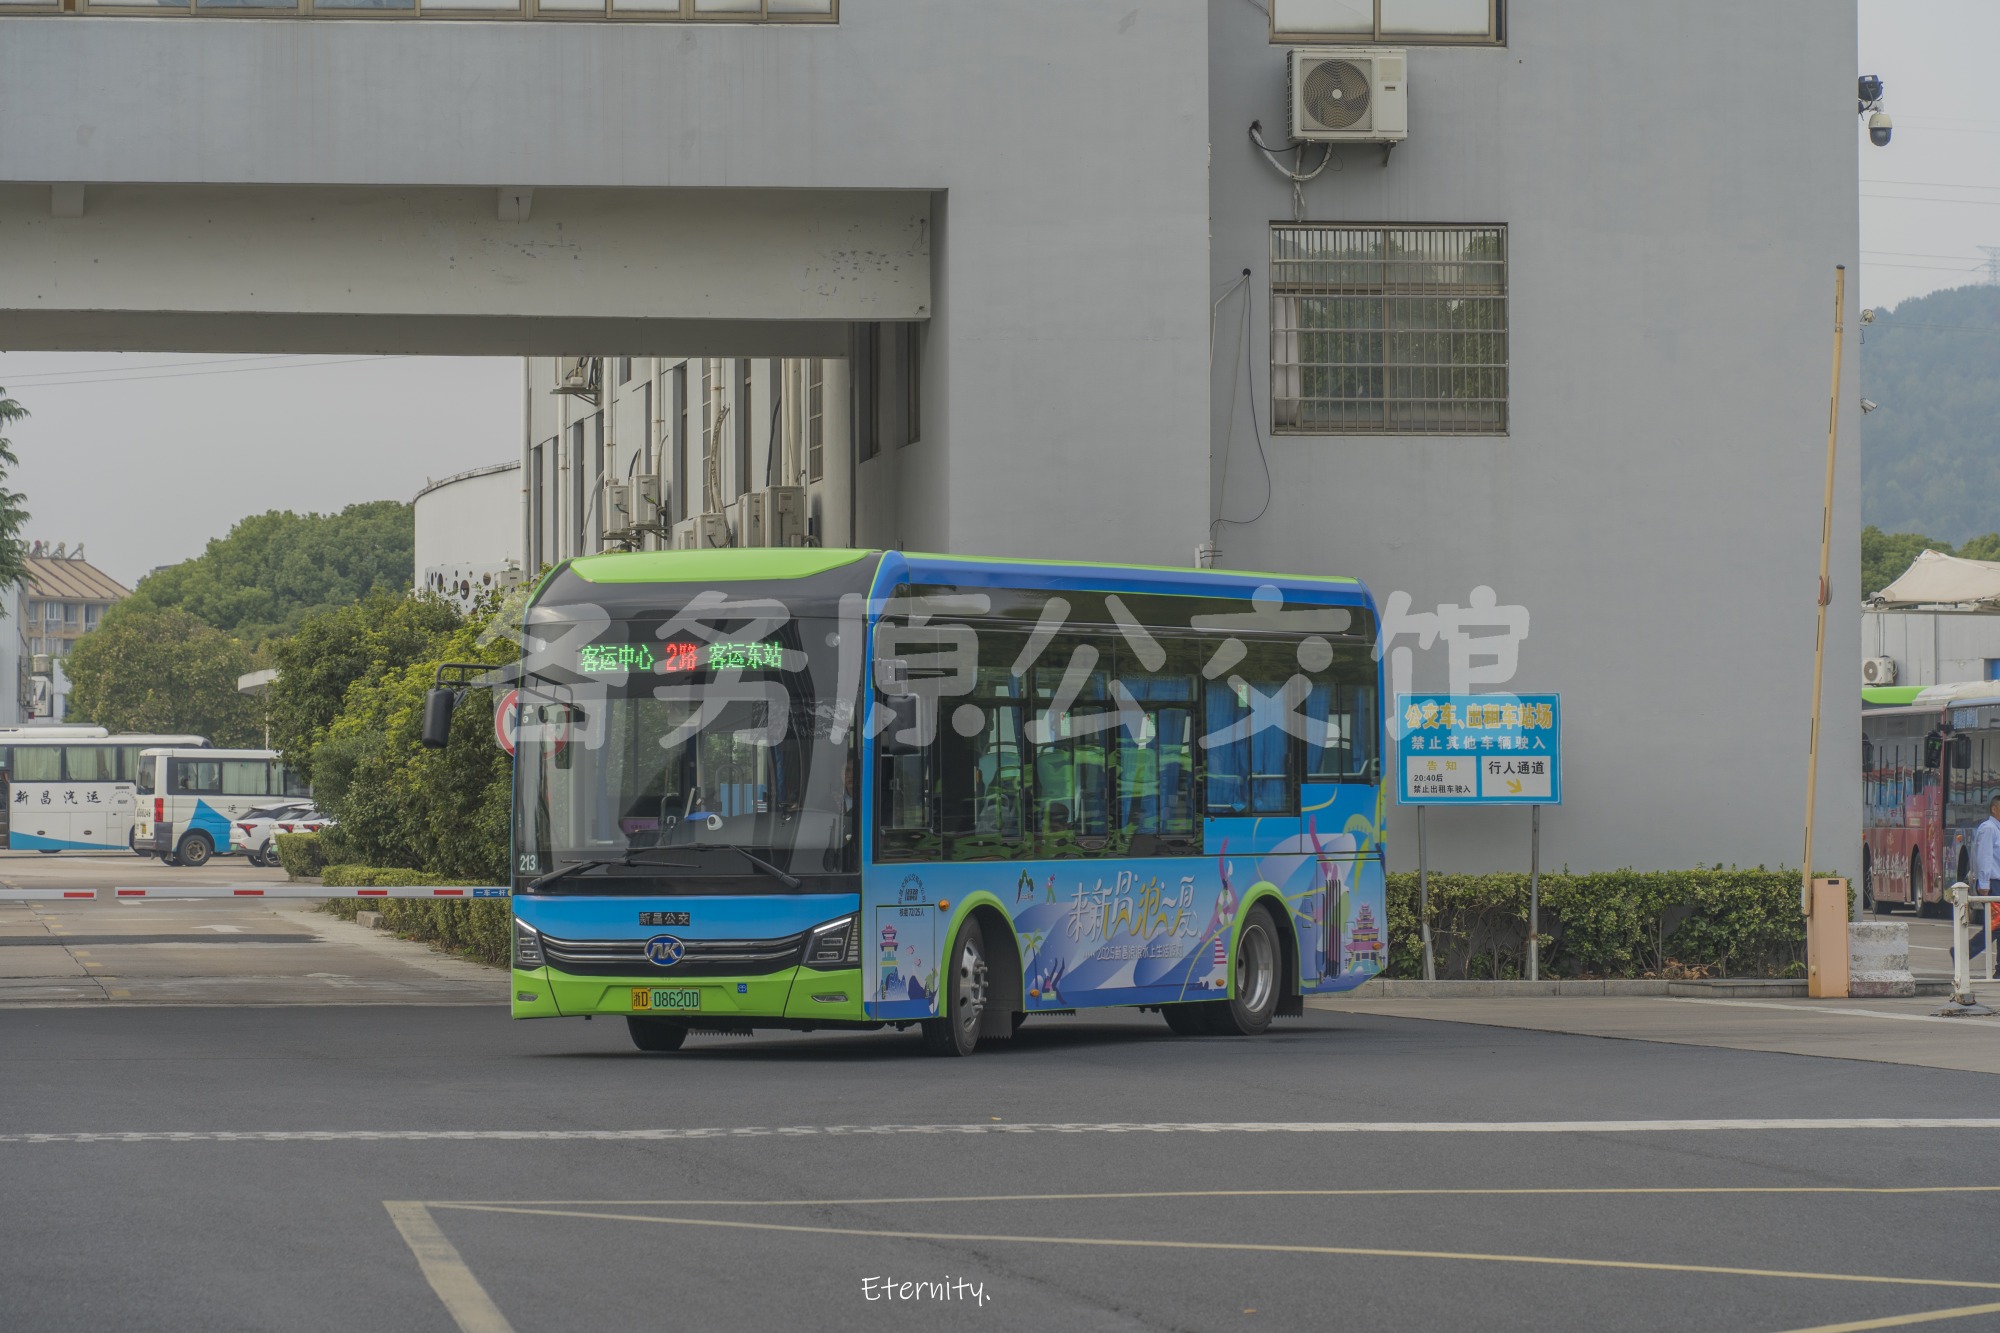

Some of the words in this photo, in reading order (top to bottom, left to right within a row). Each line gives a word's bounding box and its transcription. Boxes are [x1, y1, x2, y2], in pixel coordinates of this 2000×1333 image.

[580, 644, 654, 672] 客运中心
[666, 643, 698, 671] 2路
[708, 641, 783, 670] 客运东站
[1405, 703, 1552, 730] 公交车、出租车站场
[1411, 735, 1546, 750] 禁止其他车辆驶入
[1426, 761, 1457, 772] 告知
[1488, 761, 1545, 775] 行人通道
[1413, 774, 1443, 782] 20:40后
[1413, 784, 1471, 794] 禁止出租车驶入
[14, 789, 102, 806] 新昌汽运
[519, 854, 536, 871] 213
[639, 912, 690, 926] 新昌公交
